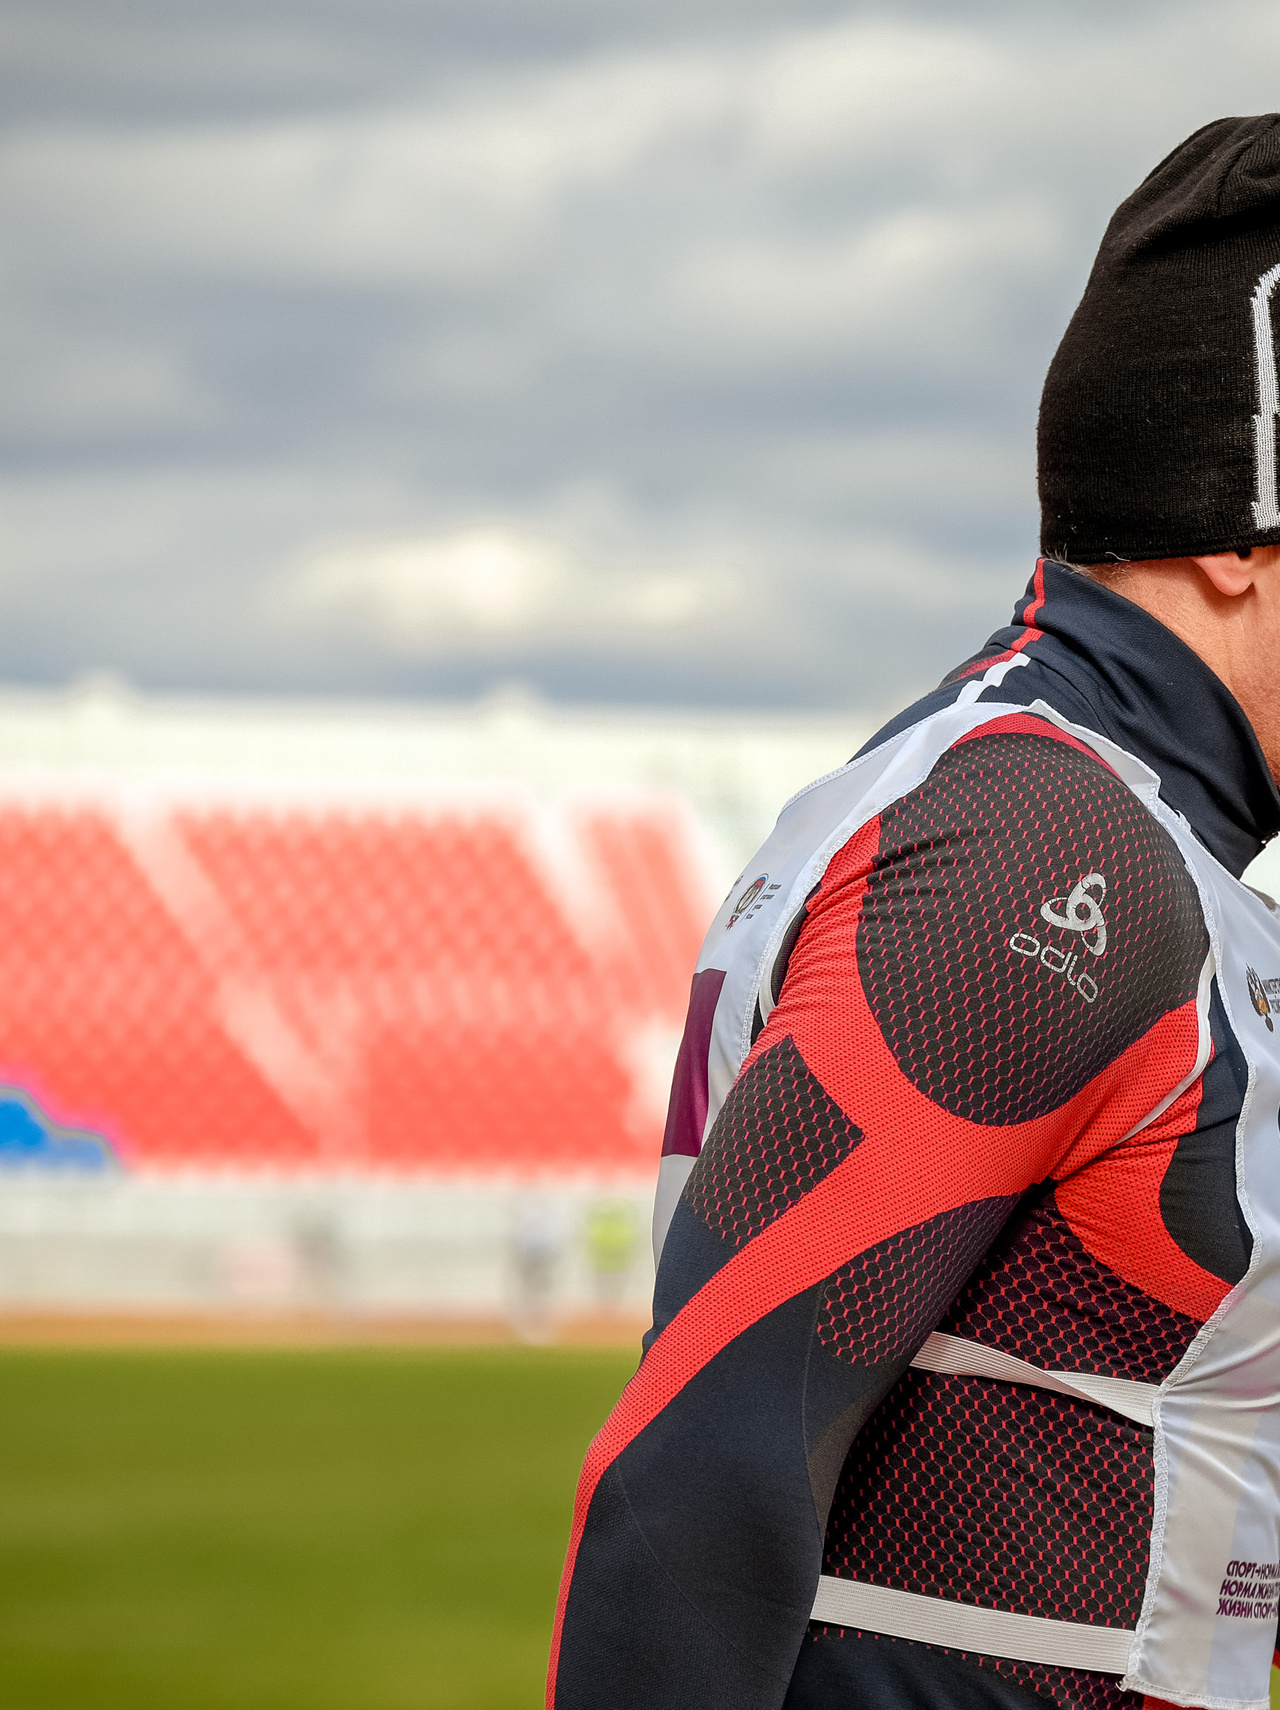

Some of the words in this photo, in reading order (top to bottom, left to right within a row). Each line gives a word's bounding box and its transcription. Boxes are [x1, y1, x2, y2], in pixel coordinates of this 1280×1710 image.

[1009, 932, 1098, 1003] odlo
[1220, 1579, 1257, 1599] НОРМА
[1216, 1598, 1254, 1619] ЖИЗНИ
